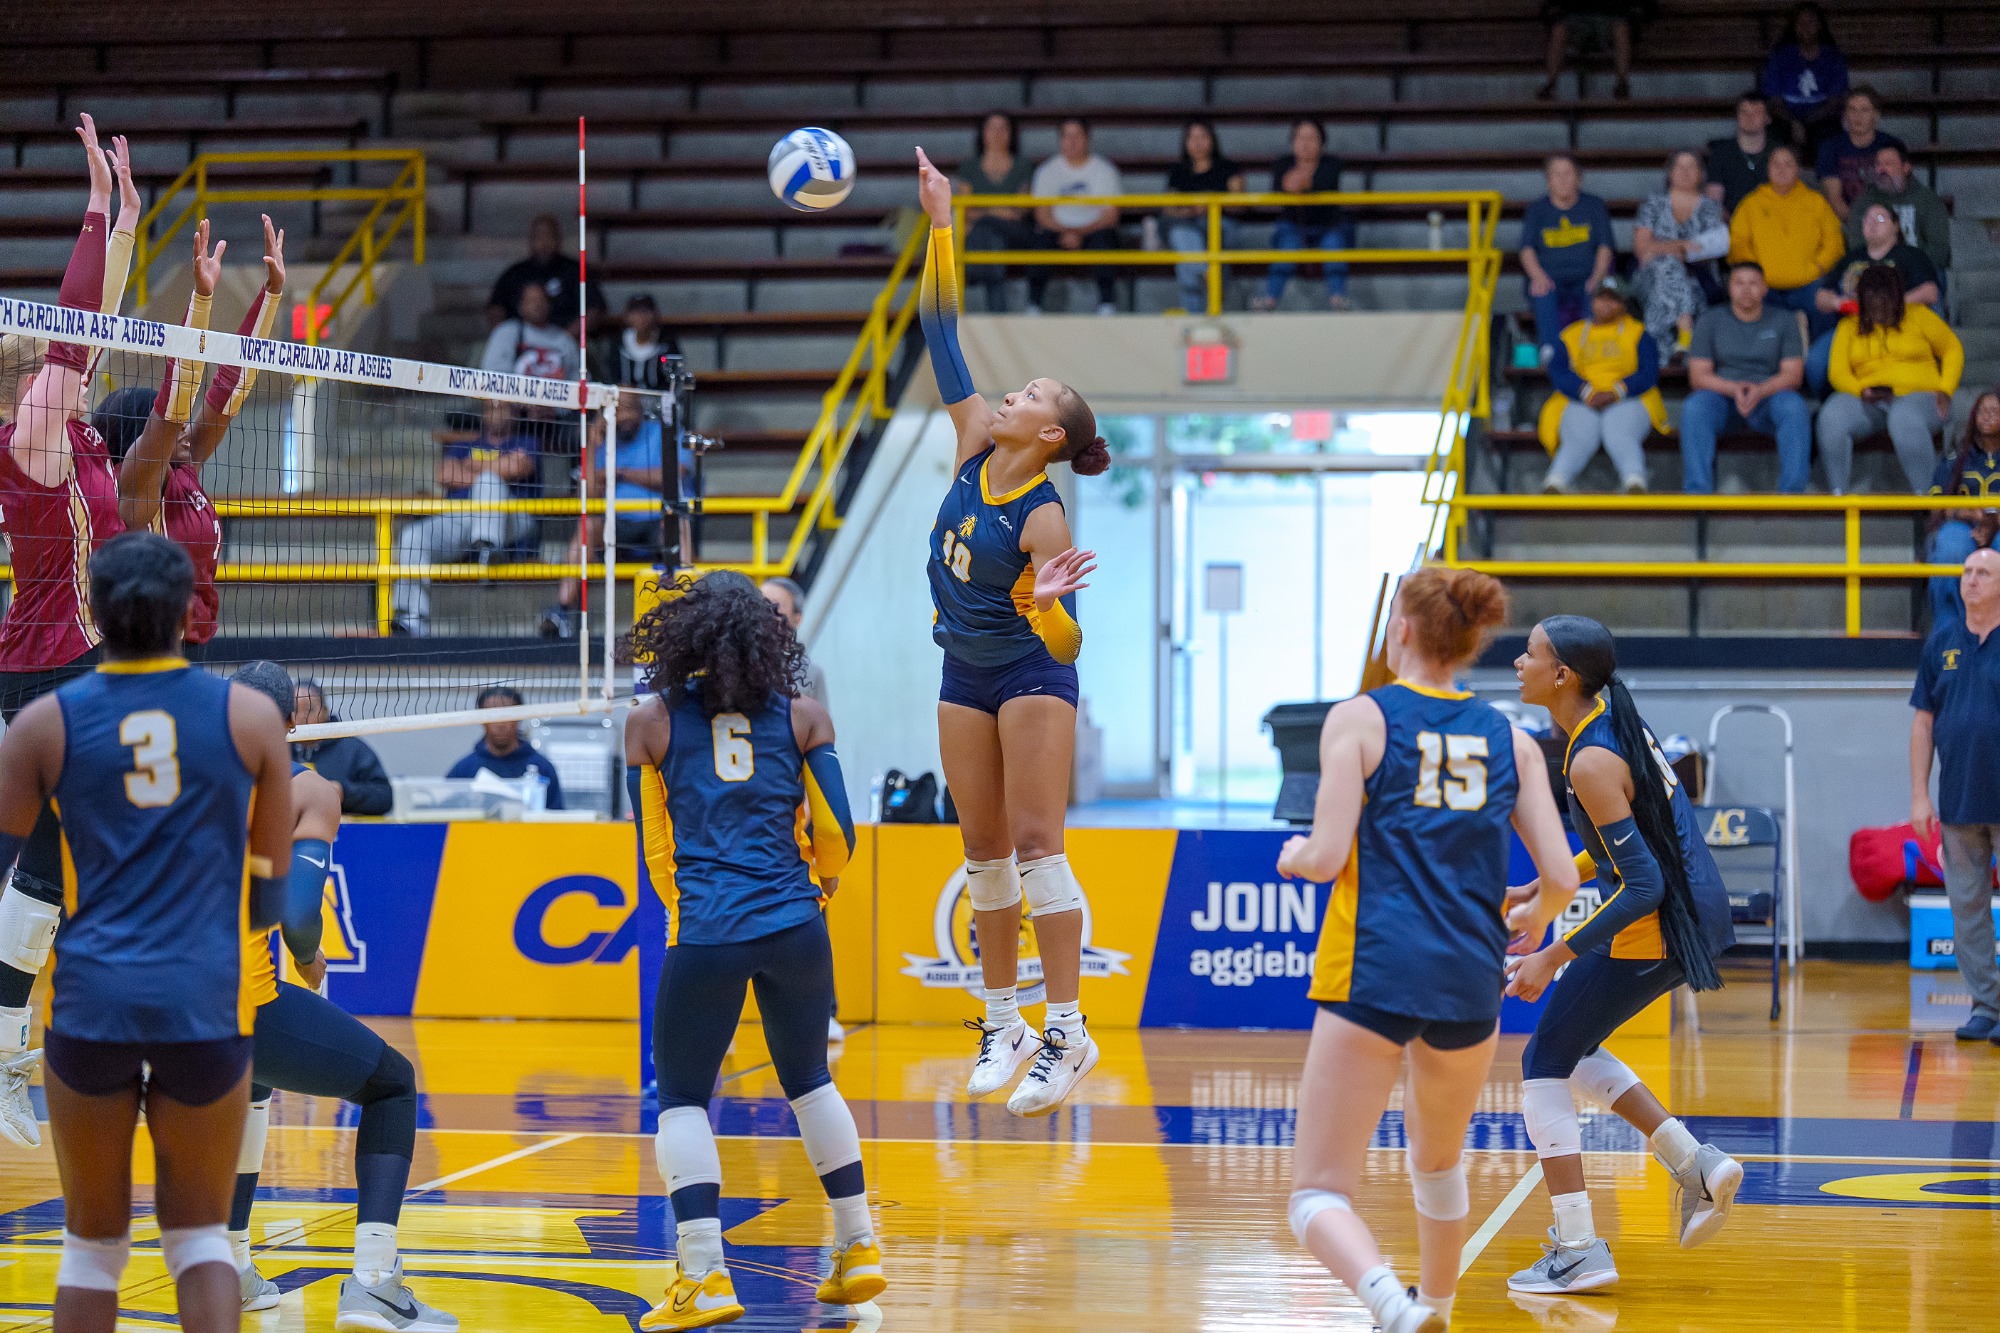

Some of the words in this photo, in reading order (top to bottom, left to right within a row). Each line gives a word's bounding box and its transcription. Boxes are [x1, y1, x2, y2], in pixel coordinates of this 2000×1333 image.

[16, 301, 86, 337] CAROLINA
[89, 313, 118, 341] A&T
[121, 318, 166, 348] AGGIES
[239, 336, 277, 365] NORTH
[278, 343, 331, 372] CAROLINA
[333, 351, 356, 375] A&T
[357, 354, 393, 380] AGGIES
[449, 368, 479, 391] NORTH
[480, 372, 521, 397] CAROLINA
[942, 529, 973, 583] 10
[118, 707, 182, 810] 3
[711, 711, 756, 783] 6
[1413, 729, 1490, 812] 15
[1190, 881, 1316, 934] JOIN
